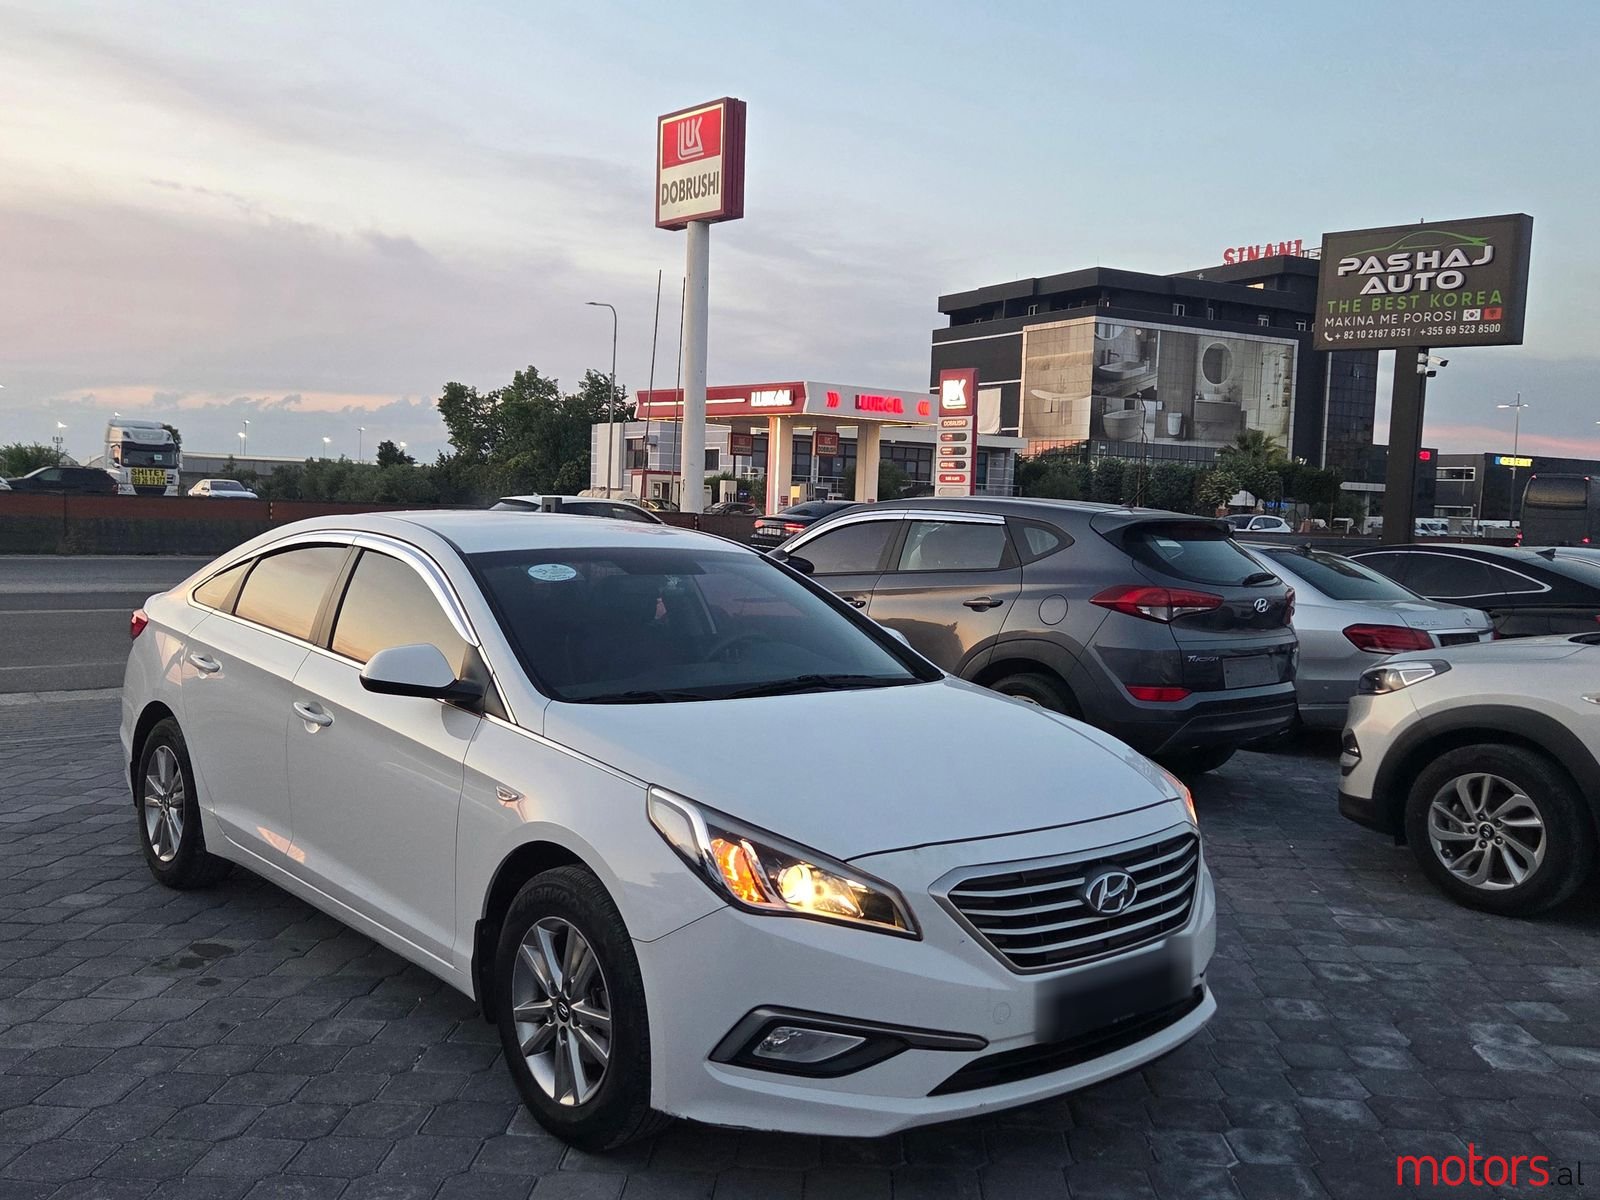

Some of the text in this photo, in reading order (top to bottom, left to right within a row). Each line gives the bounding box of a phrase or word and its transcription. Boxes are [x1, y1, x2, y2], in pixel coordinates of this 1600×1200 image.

[661, 171, 720, 206] DOBRUSHI
[1223, 239, 1302, 265] SINANI
[1337, 245, 1494, 276] PASHAJ
[1360, 270, 1465, 295] AUTO
[1327, 290, 1502, 314] THE BEST KOREA
[1324, 311, 1457, 328] MAKINA ME POROSI
[1391, 328, 1411, 337] 8751
[1420, 326, 1444, 336] +355
[1446, 325, 1457, 334] 69
[1459, 324, 1476, 334] 523
[1478, 323, 1501, 333] 8500
[131, 468, 166, 476] SHITET
